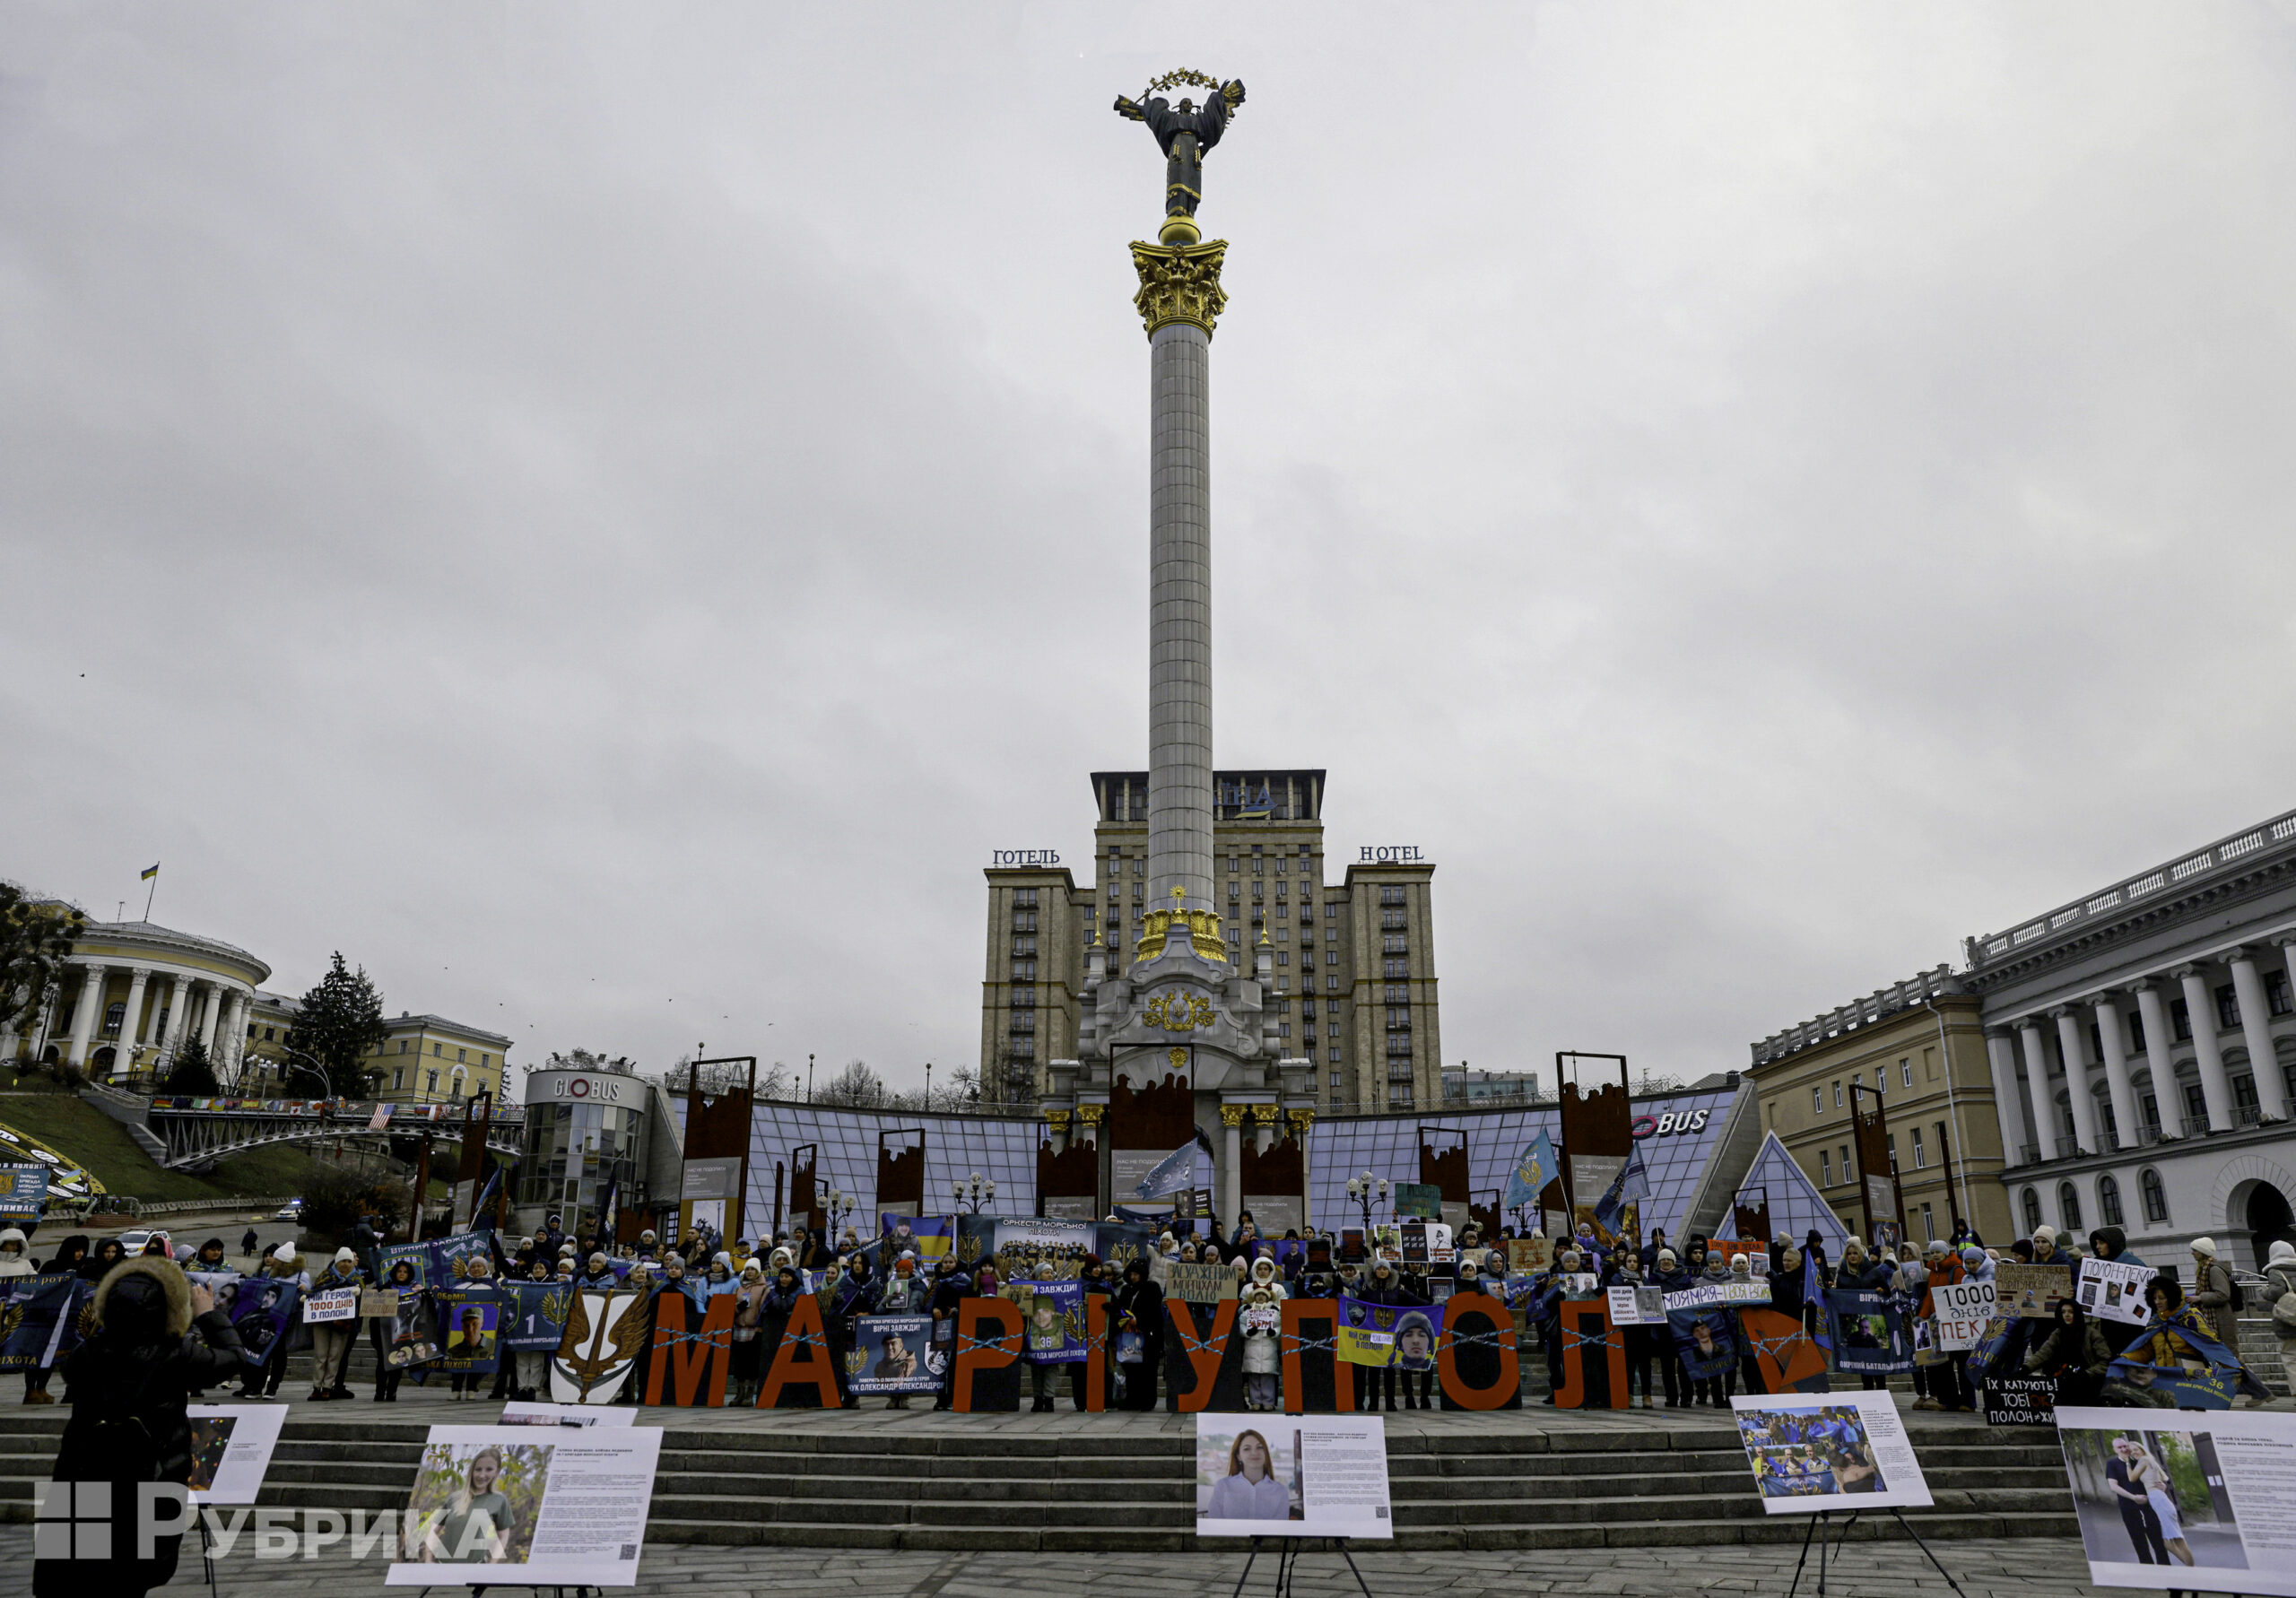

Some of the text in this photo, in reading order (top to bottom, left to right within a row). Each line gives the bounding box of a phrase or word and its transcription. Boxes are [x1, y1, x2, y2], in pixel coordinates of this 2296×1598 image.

[993, 849, 1060, 864] ГОТЕЛЬ
[1360, 846, 1424, 860] HOTEL
[554, 1078, 620, 1100] GLOBUS
[1631, 1109, 1709, 1136] OBUS
[1003, 1220, 1087, 1229] ОРКЕСТР МОРСЬКОЇ
[1029, 1228, 1060, 1237] ПІХОТИ
[1170, 1264, 1237, 1281] ЗАСУДЖЕНИМ
[1039, 1283, 1077, 1294] ЗАВЖДИ!
[1173, 1280, 1222, 1291] МОРПІХАМ
[308, 1290, 352, 1302] МІЙ ГЕРОЙ
[1943, 1284, 1995, 1307] 1000
[309, 1302, 334, 1311] 1000
[335, 1298, 353, 1309] ДНІВ
[311, 1309, 348, 1319] В ПОЛОНІ
[526, 1314, 534, 1335] 1
[873, 1324, 920, 1333] ВІРНІ ЗАВЖДИ!
[1040, 1336, 1052, 1347] 36
[0, 1356, 37, 1365] ІХОТА
[443, 1360, 473, 1369] ПІХОТА
[860, 1383, 897, 1392] ОЛЕКСАНДР
[899, 1382, 945, 1390] ОЛЕКСАНДРО
[1985, 1377, 2058, 1391] ЇХ КАТУЮТЬ!
[2208, 1378, 2224, 1390] 36
[2000, 1393, 2031, 1407] ТОБІ
